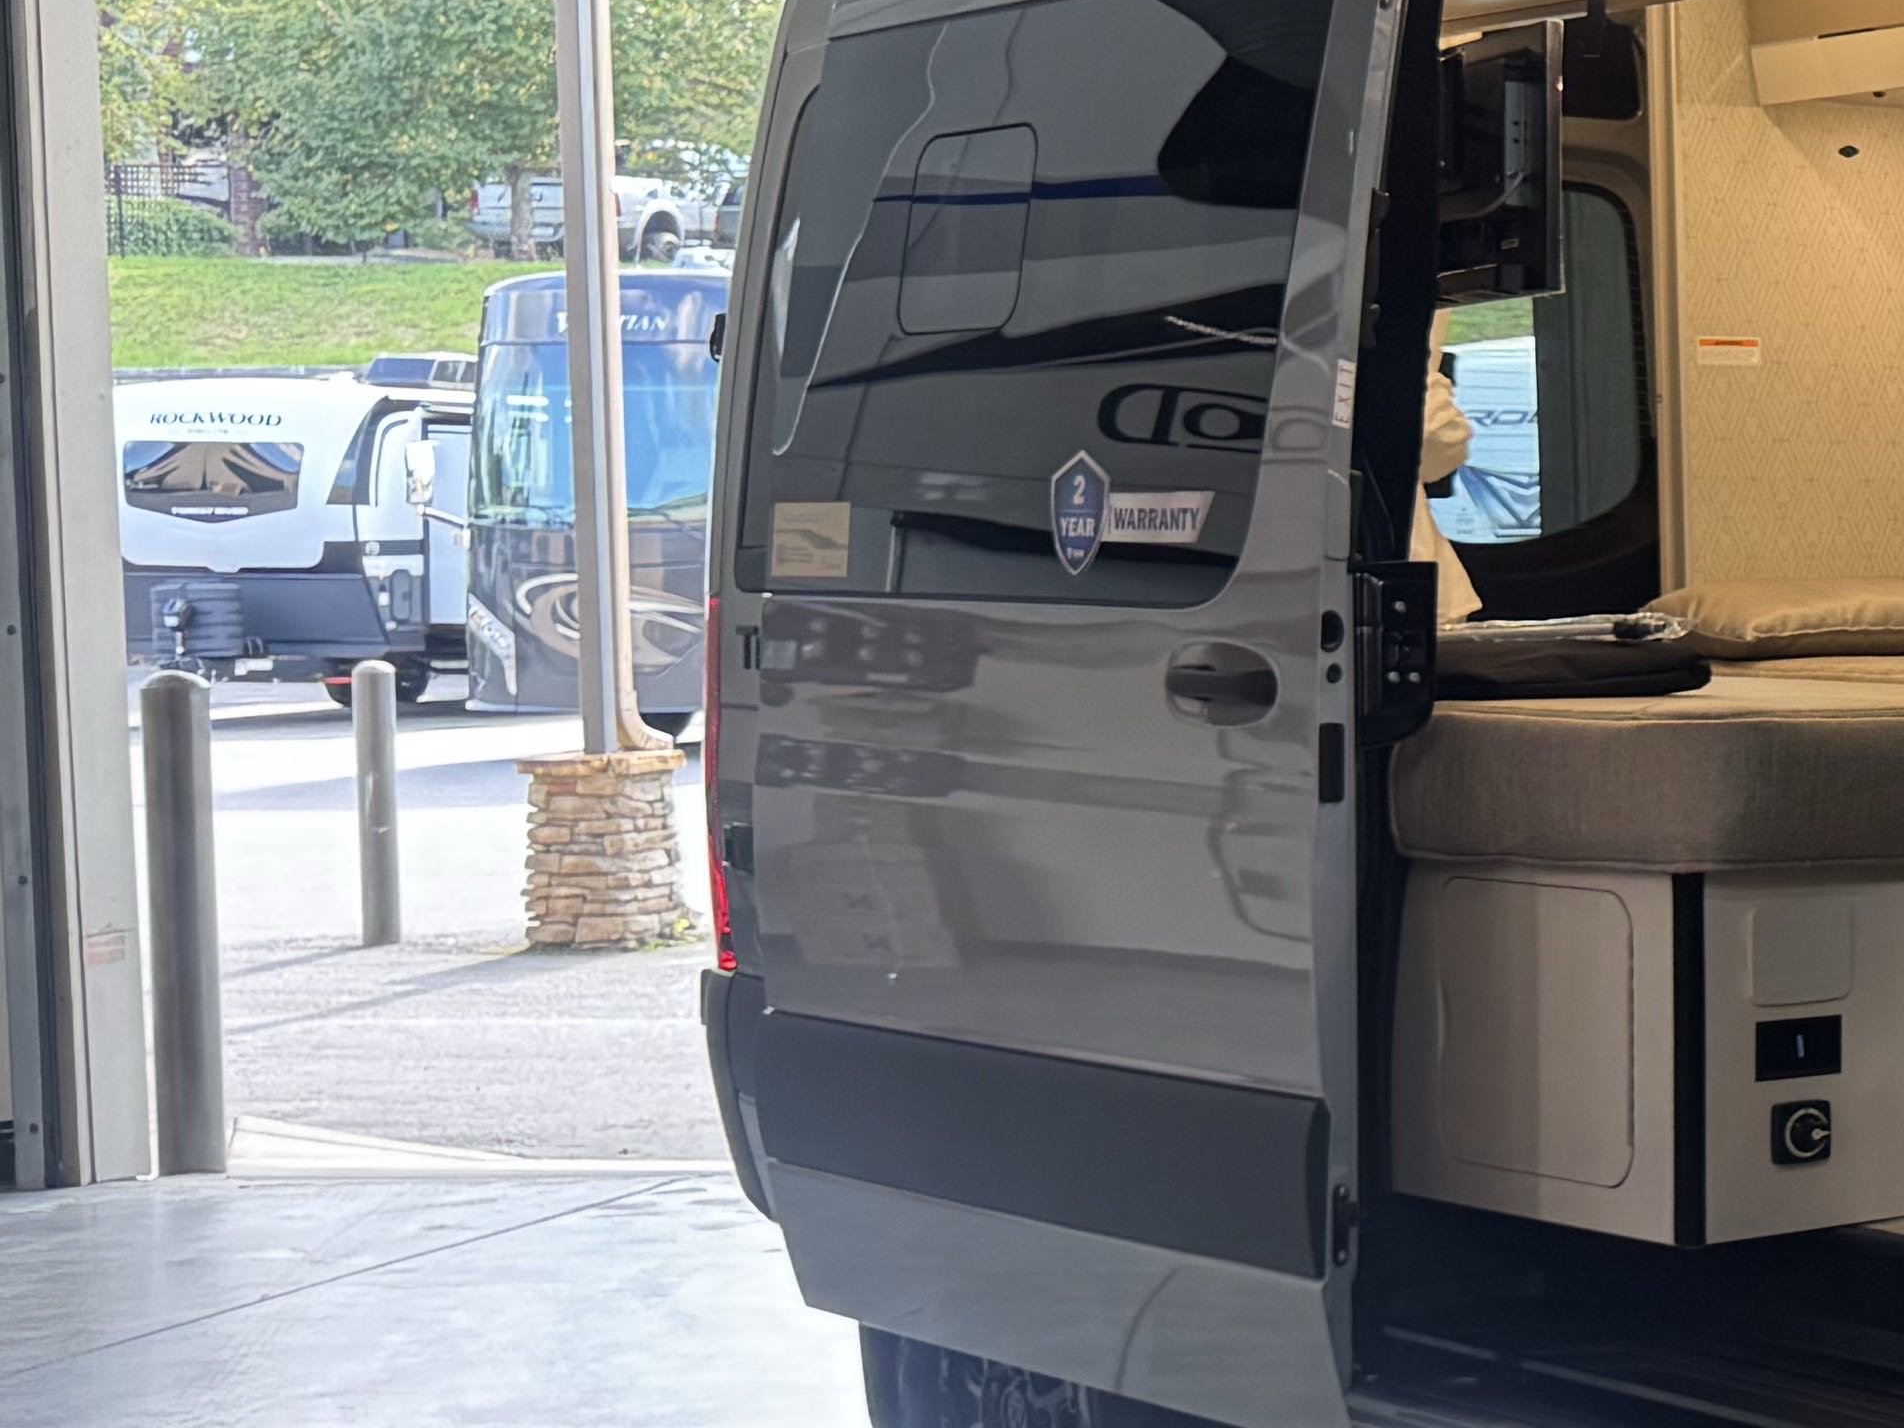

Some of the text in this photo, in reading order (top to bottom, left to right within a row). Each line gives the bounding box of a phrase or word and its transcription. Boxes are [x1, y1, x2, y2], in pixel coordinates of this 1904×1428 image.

[1335, 366, 1353, 424] EXIT
[150, 411, 283, 427] ROCKWOOD
[1073, 475, 1087, 506] 2
[1060, 517, 1097, 538] YEAR
[1114, 507, 1201, 532] WARRANTY
